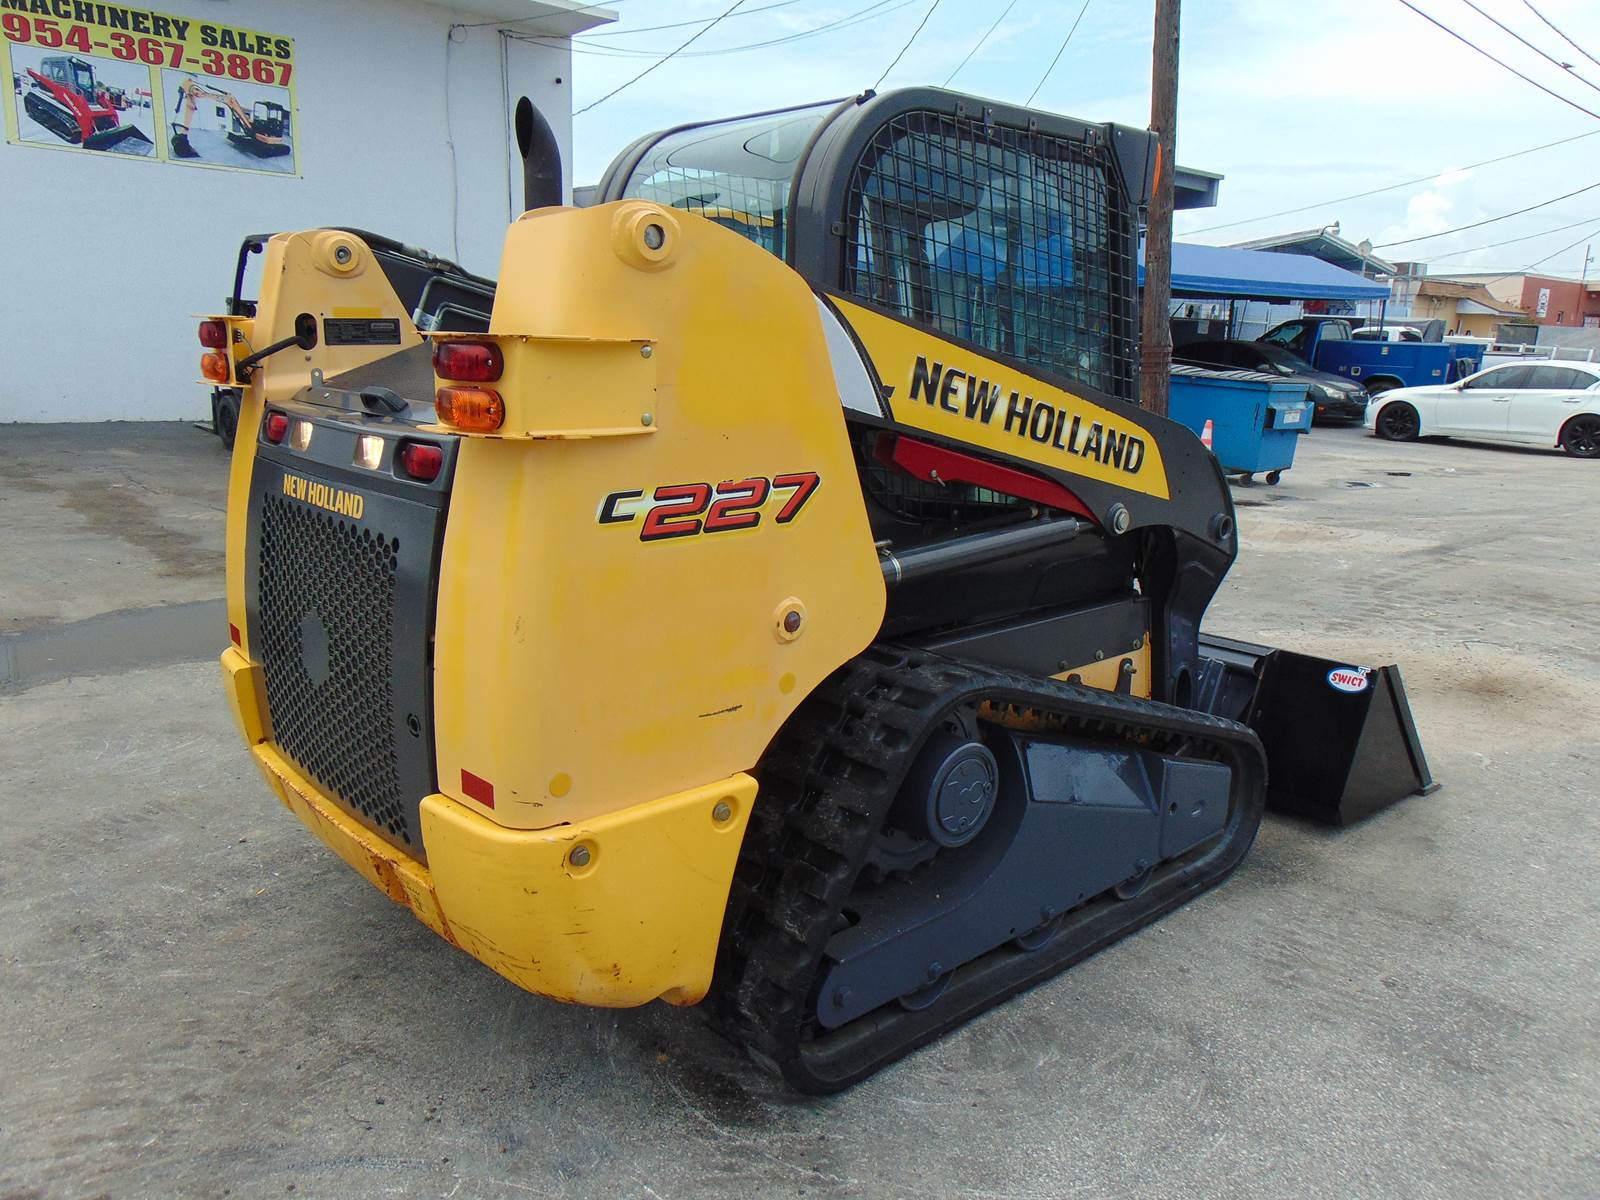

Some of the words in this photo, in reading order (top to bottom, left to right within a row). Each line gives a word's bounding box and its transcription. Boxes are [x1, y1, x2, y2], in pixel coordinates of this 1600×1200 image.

[2, 13, 292, 87] 954-367-3867
[200, 25, 291, 60] SALES
[909, 355, 1001, 425] NEW
[1003, 391, 1146, 474] HOLLAND
[283, 473, 307, 501] NEW
[307, 481, 364, 520] HOLLAND
[598, 471, 820, 542] C227
[1331, 672, 1364, 687] SWICT
